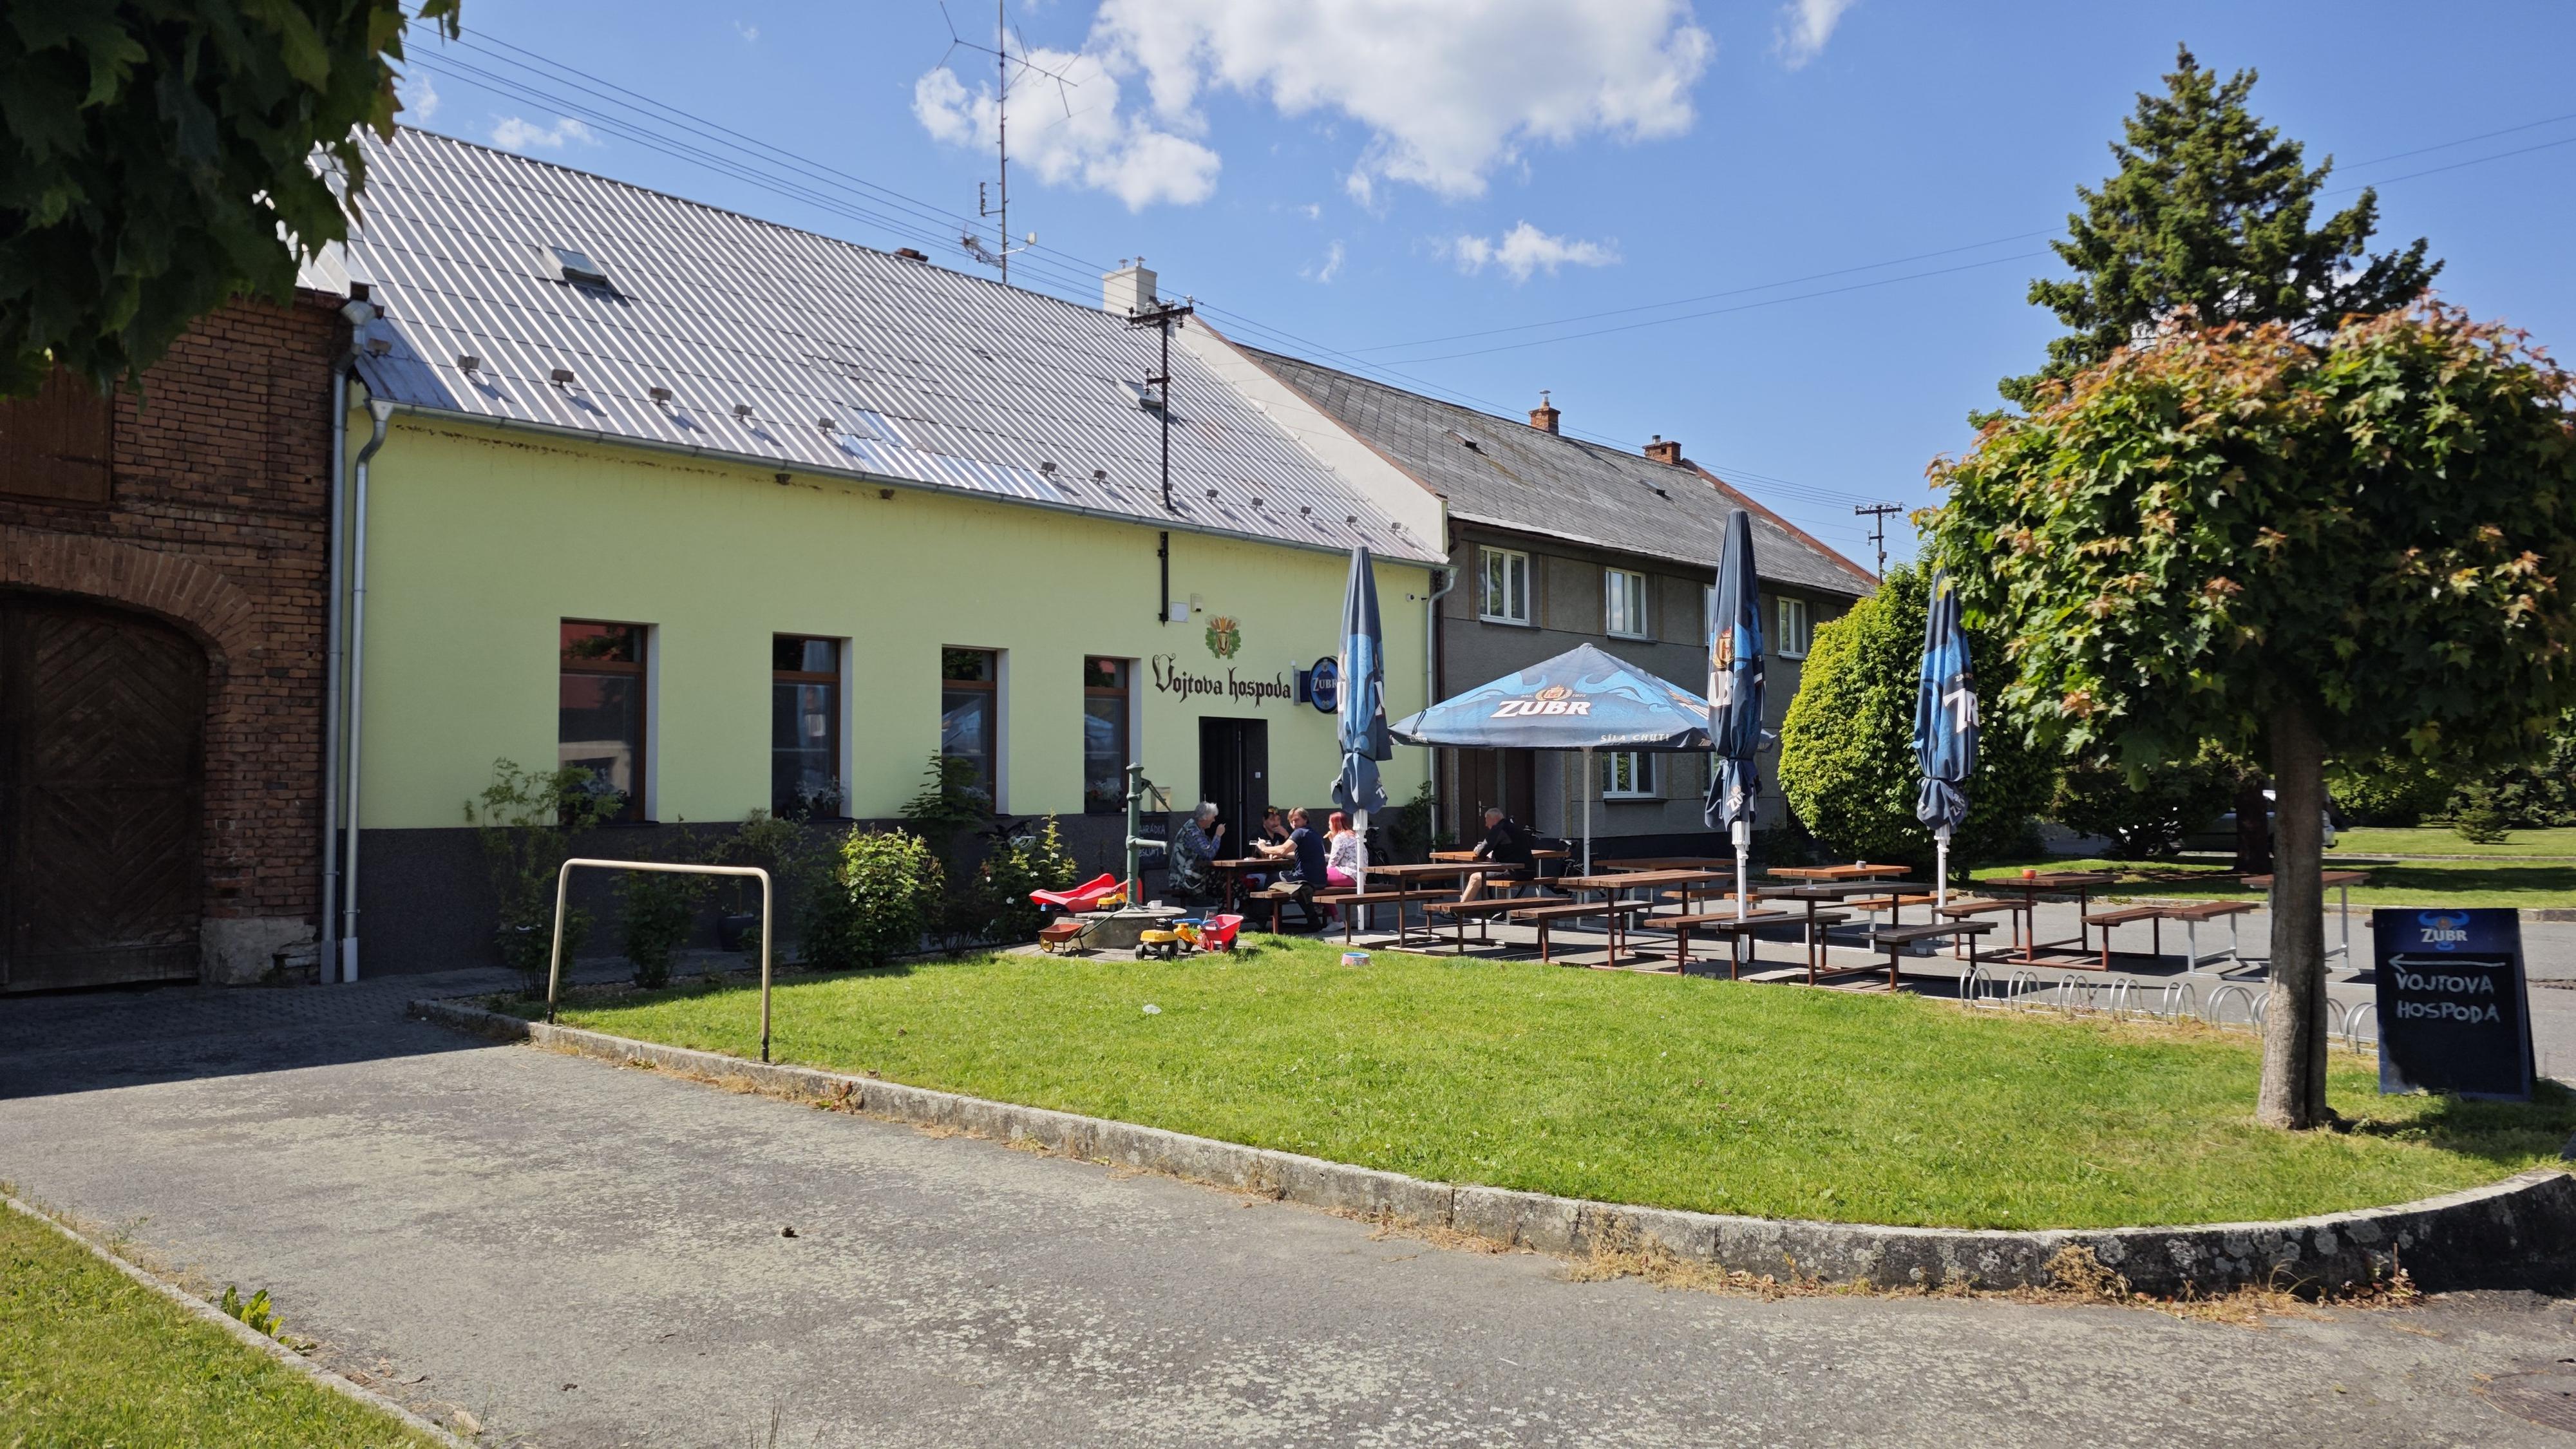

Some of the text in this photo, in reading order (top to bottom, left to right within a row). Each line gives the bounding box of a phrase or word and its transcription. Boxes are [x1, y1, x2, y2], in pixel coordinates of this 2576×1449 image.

[1152, 653, 1222, 703] Vojtova
[1227, 667, 1291, 708] hospoda
[1490, 700, 1591, 717] ZUBR
[1632, 733, 1670, 743] CHUTI
[2421, 928, 2468, 942] ZUBR
[2394, 972, 2494, 994] VOJTOVA
[2396, 1000, 2500, 1024] HOSPODA
